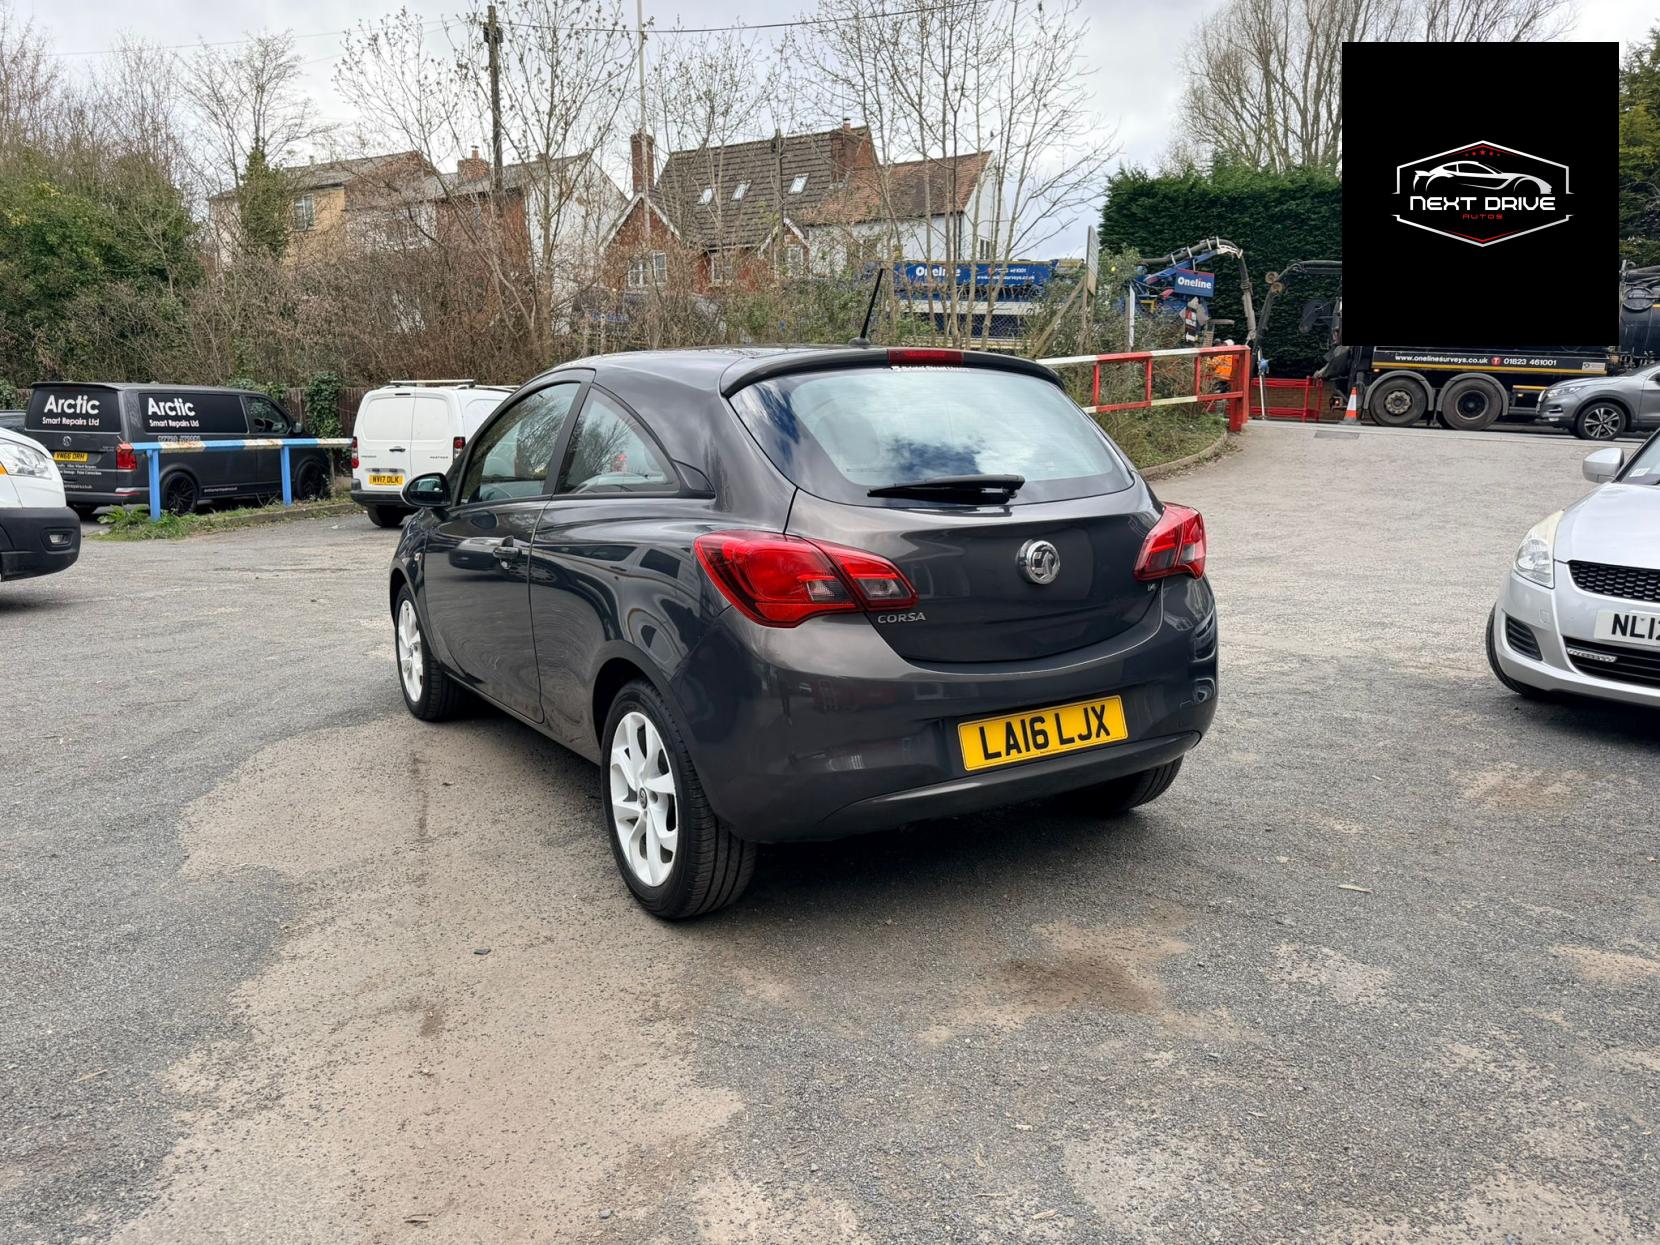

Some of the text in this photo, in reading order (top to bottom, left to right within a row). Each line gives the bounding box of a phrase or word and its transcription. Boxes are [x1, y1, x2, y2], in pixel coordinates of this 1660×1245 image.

[915, 266, 961, 277] Oelie
[1177, 276, 1212, 289] Oneline
[1395, 355, 1488, 364] www.onelinesurveys.co.uk
[1503, 358, 1527, 366] 01823
[43, 394, 100, 415] Arctic
[148, 397, 196, 416] Arctic
[42, 417, 100, 426] Smart Repairs Ltd
[149, 419, 168, 427] Smart
[168, 420, 190, 428] Repairs
[877, 612, 927, 624] CORSA
[978, 704, 1111, 761] LA16 LJX
